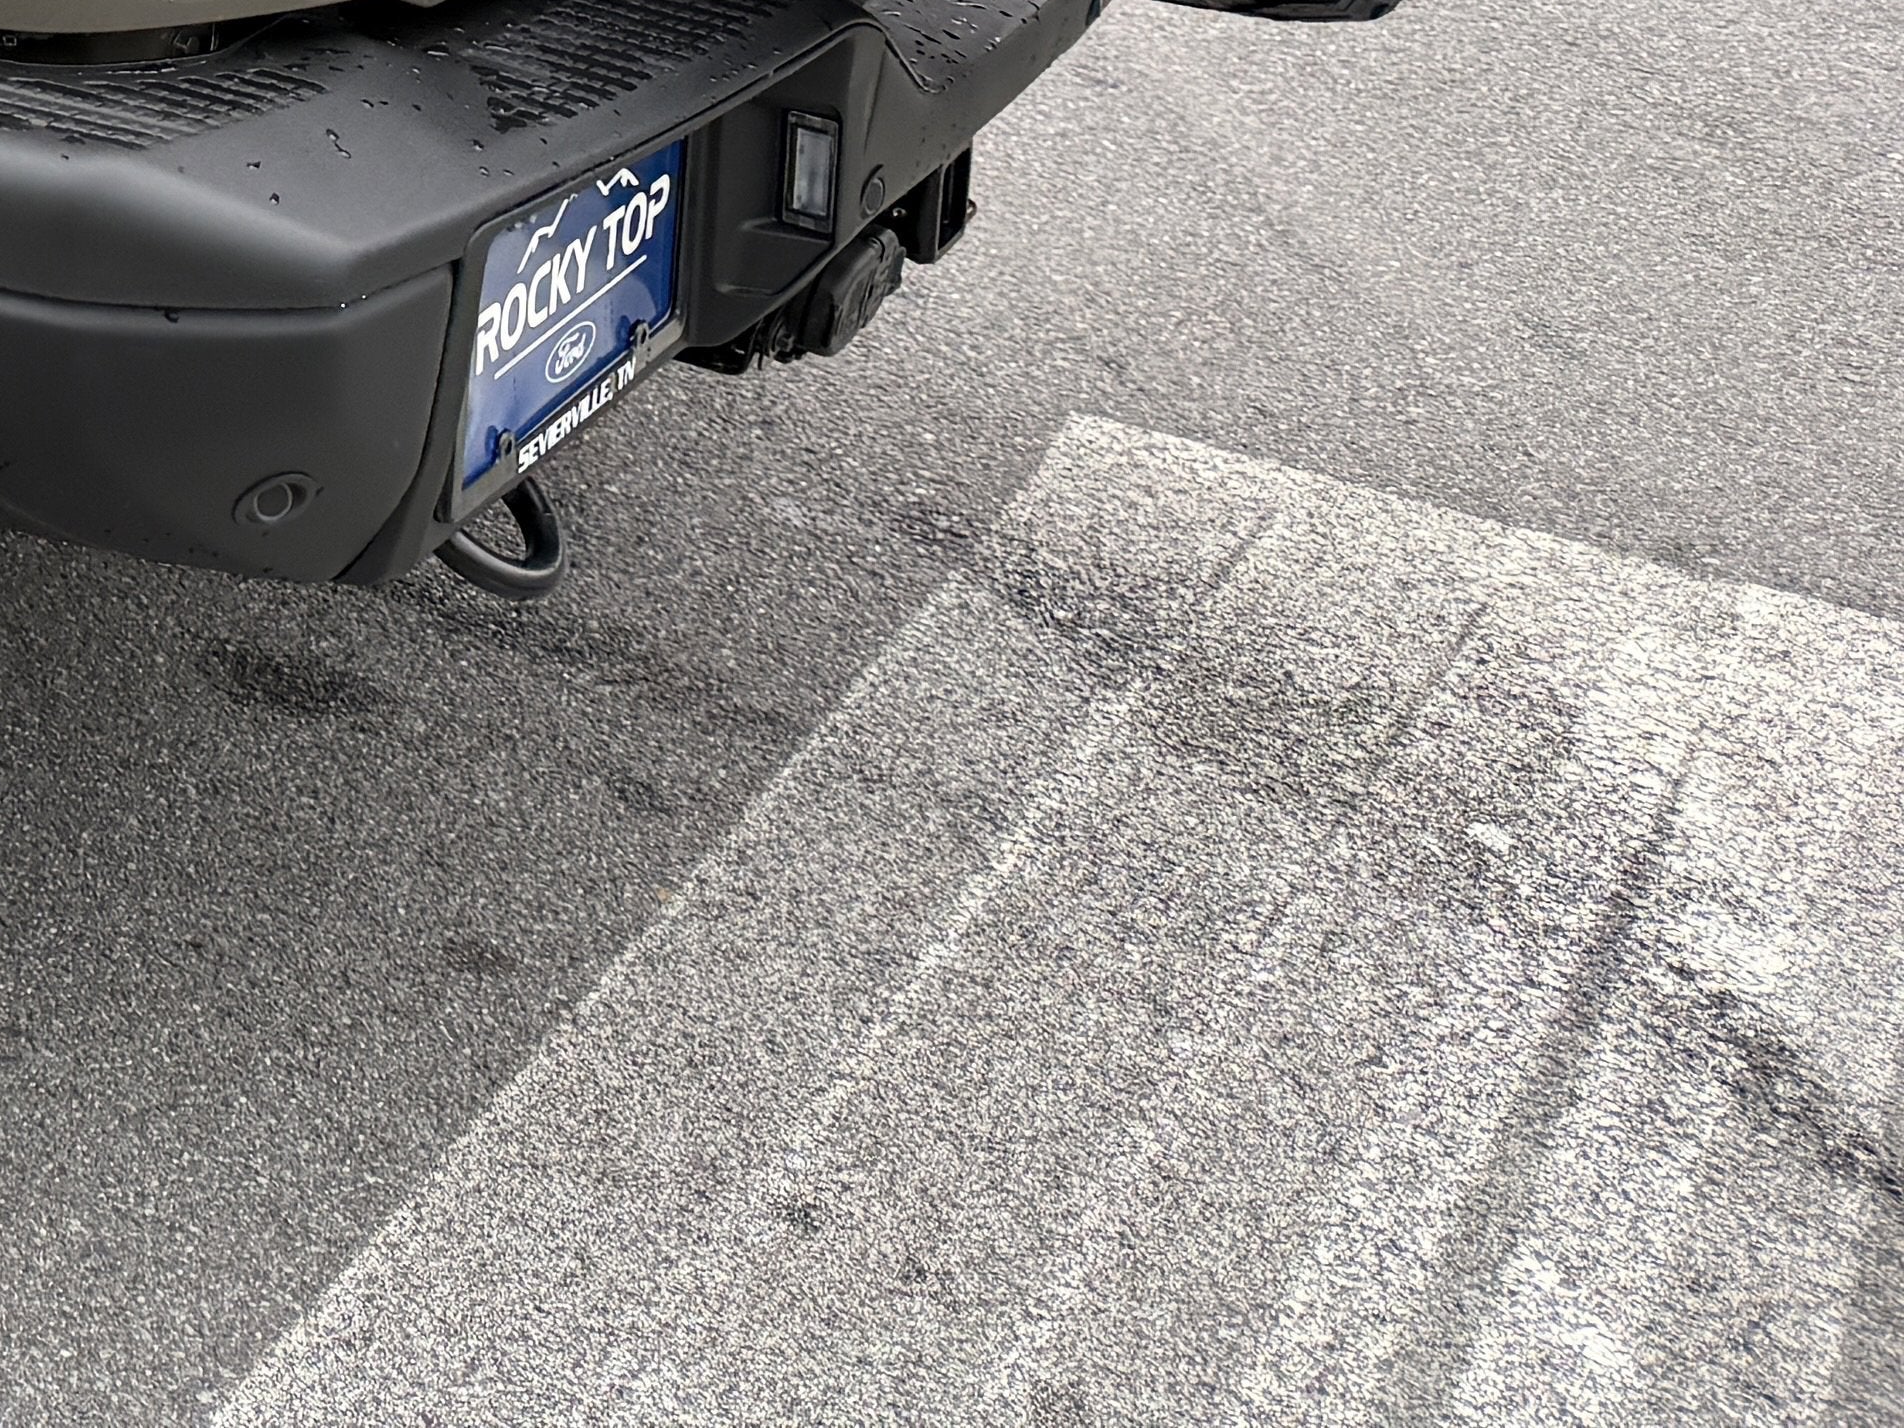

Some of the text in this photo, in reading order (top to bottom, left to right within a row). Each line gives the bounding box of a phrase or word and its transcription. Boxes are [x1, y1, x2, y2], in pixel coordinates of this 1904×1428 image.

[475, 173, 671, 376] ROCKY TOP
[555, 332, 587, 375] Ford
[617, 355, 637, 391] TN
